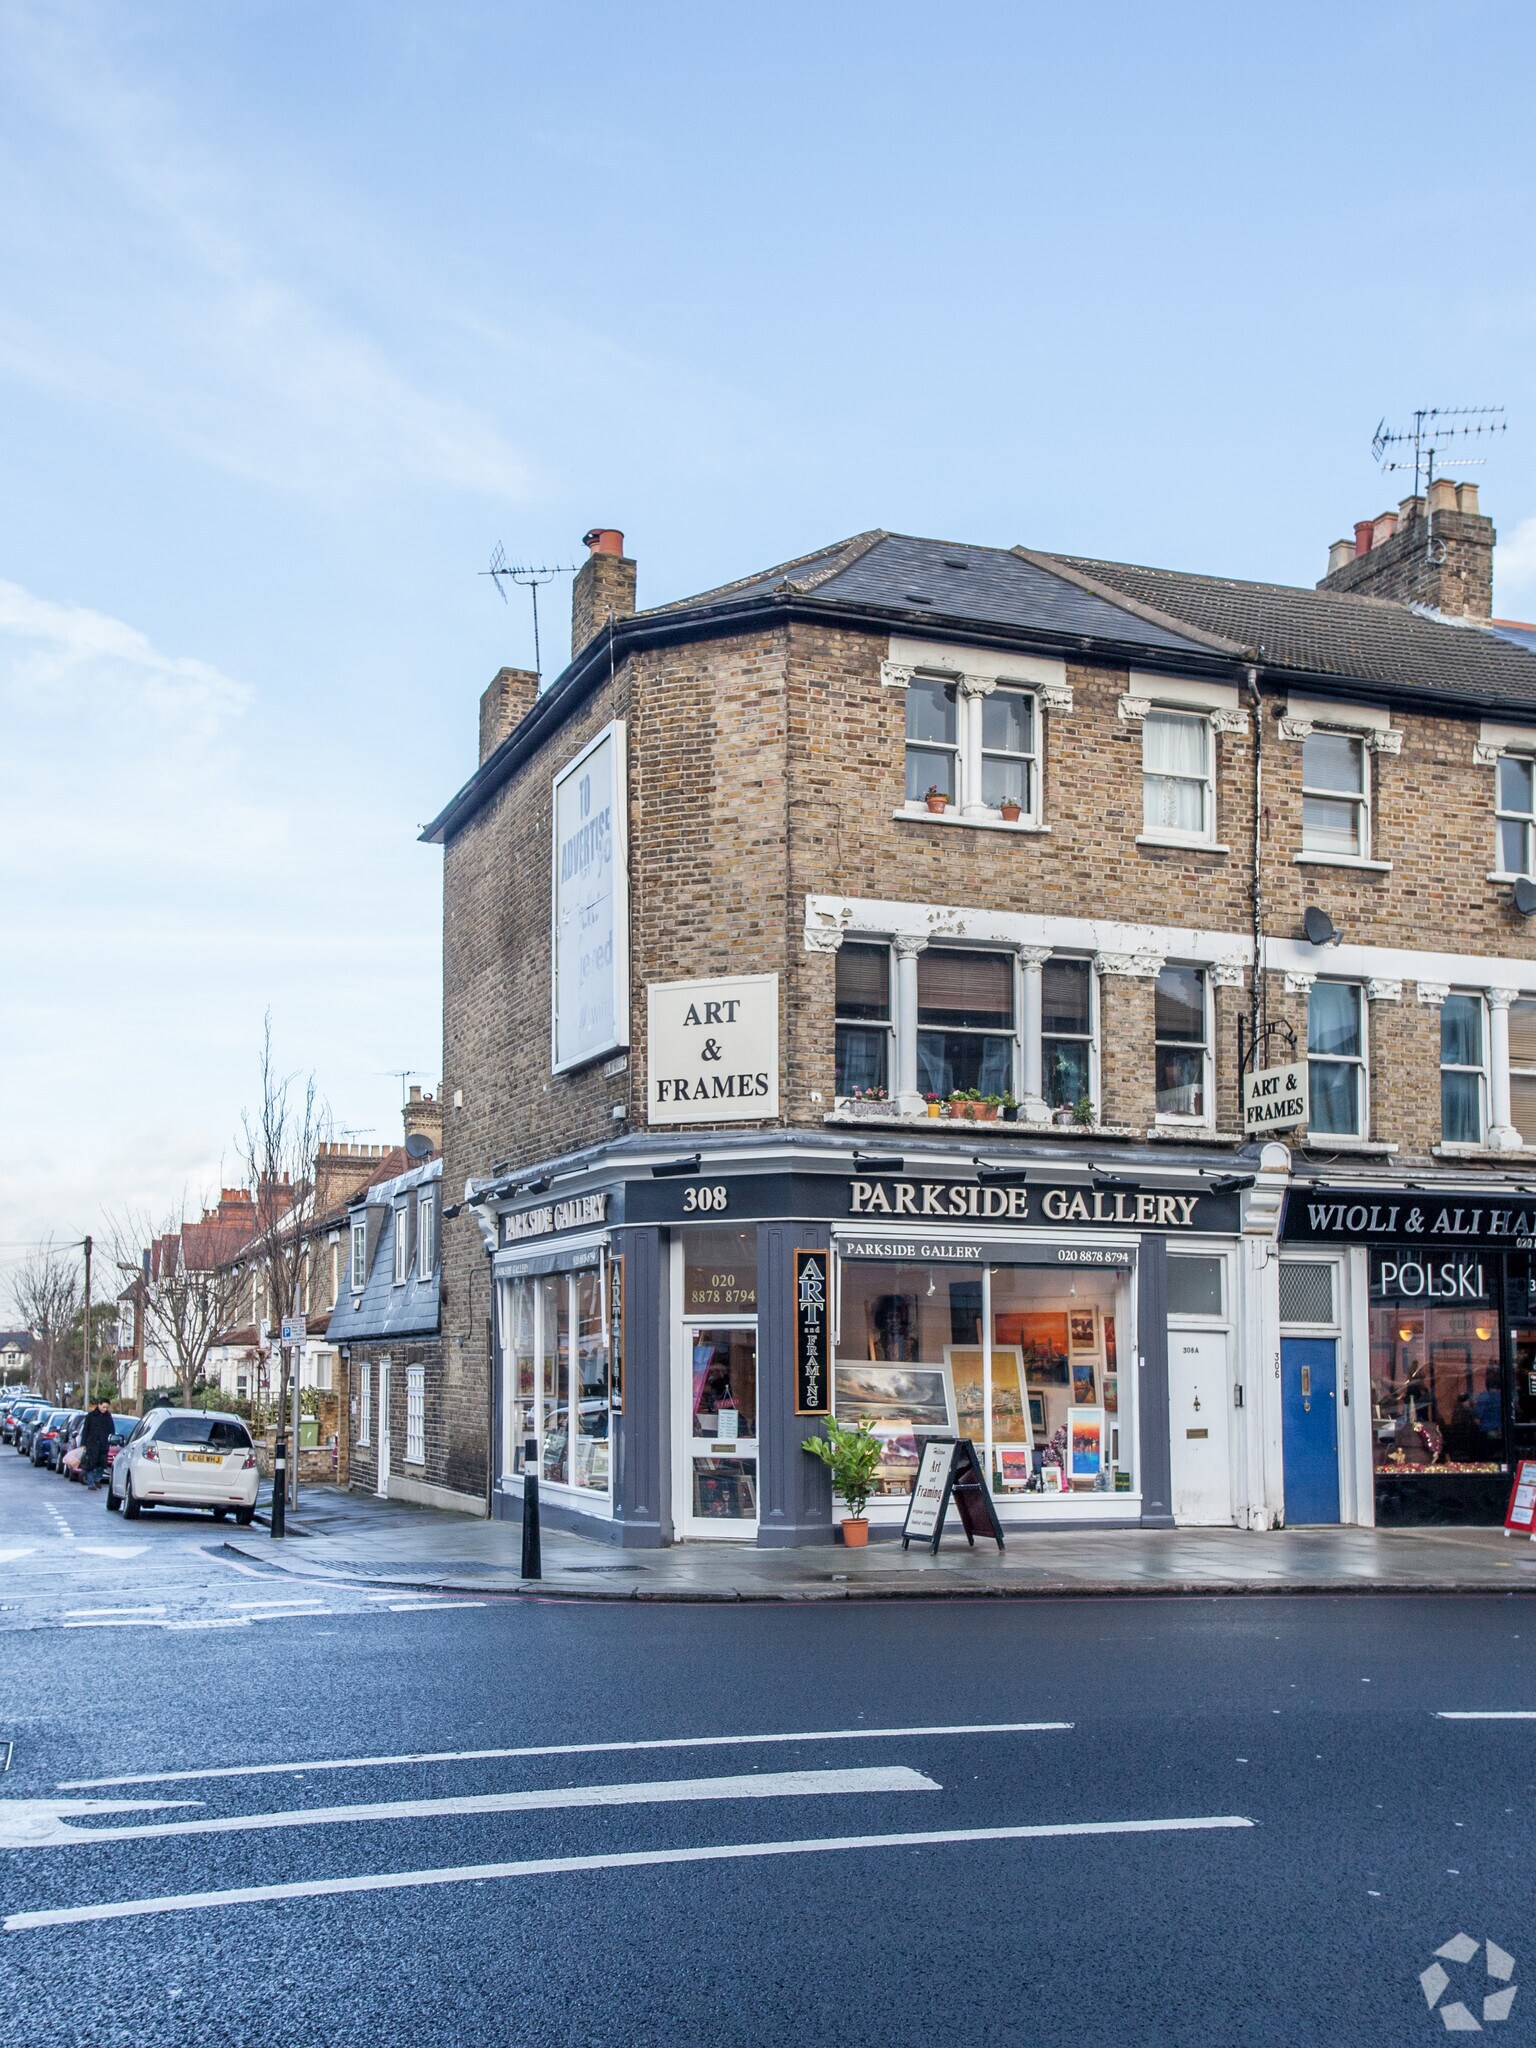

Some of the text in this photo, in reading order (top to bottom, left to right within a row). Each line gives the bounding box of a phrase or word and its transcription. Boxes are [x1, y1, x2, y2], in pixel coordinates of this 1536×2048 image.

[579, 774, 591, 821] TO
[561, 806, 610, 885] ADVERTISE
[682, 999, 741, 1026] ART
[701, 1038, 722, 1061] &
[656, 1072, 769, 1102] FRAMES
[1251, 1073, 1298, 1099] ART &
[1246, 1096, 1304, 1124] FRAMES
[682, 1185, 728, 1212] 308
[849, 1181, 1200, 1227] PARKSIDE GALLERY
[505, 1192, 608, 1242] PARKSIDE GALLERY
[1307, 1204, 1400, 1233] WIOLI
[1404, 1207, 1425, 1234] &
[1430, 1208, 1483, 1235] ALI
[846, 1242, 983, 1259] PARKSIDE GALLERY
[1057, 1249, 1129, 1263] 020 8878 8794
[711, 1274, 735, 1288] 020
[799, 1257, 826, 1325] ART
[1380, 1261, 1484, 1298] POLSKI
[611, 1263, 622, 1328] ART
[691, 1289, 756, 1303] 8878 8794
[804, 1326, 821, 1334] and
[805, 1334, 820, 1407] FRAMING
[930, 1460, 942, 1473] Art
[916, 1484, 943, 1503] Framing
